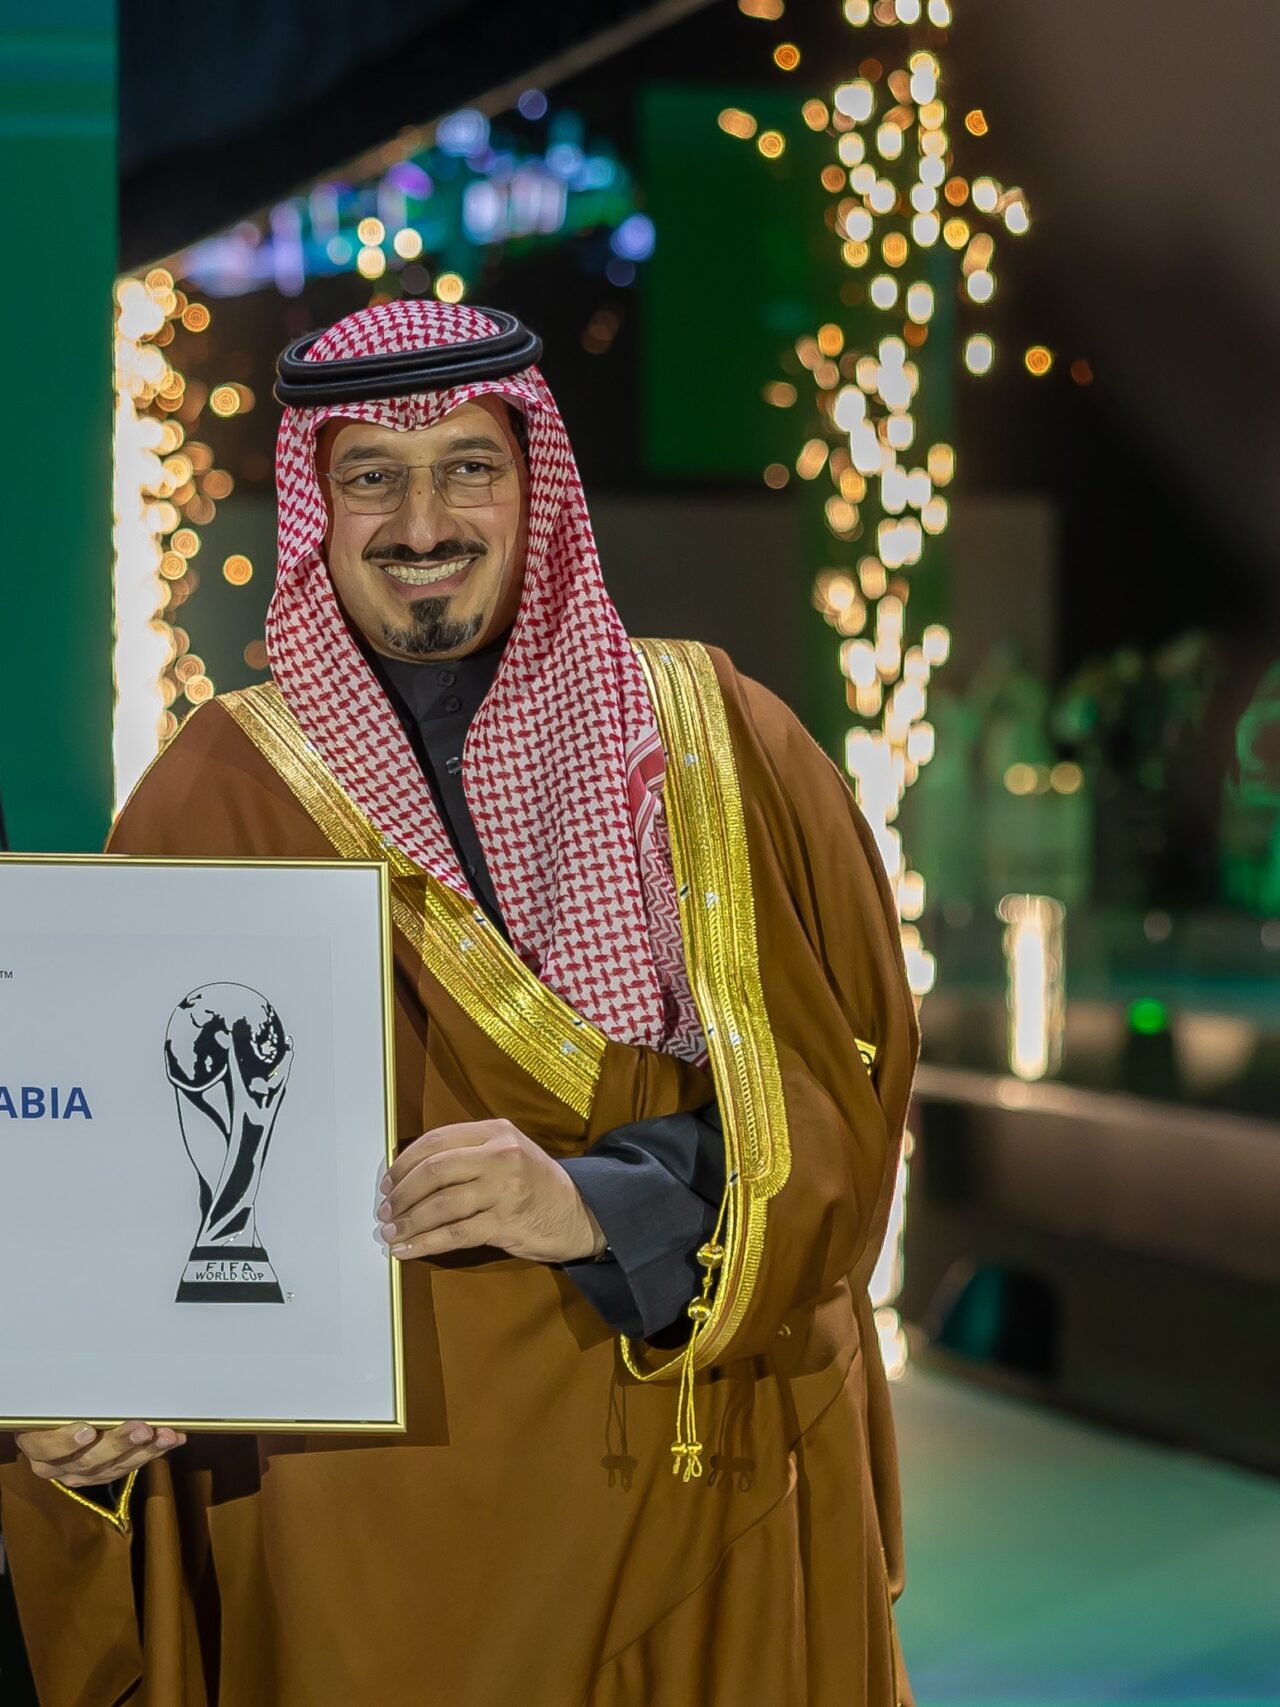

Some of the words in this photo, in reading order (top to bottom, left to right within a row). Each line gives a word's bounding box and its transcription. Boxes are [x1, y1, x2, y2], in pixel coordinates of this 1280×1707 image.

[205, 1262, 254, 1273] FIFA
[195, 1271, 238, 1281] WORLD
[242, 1271, 265, 1281] CUP
